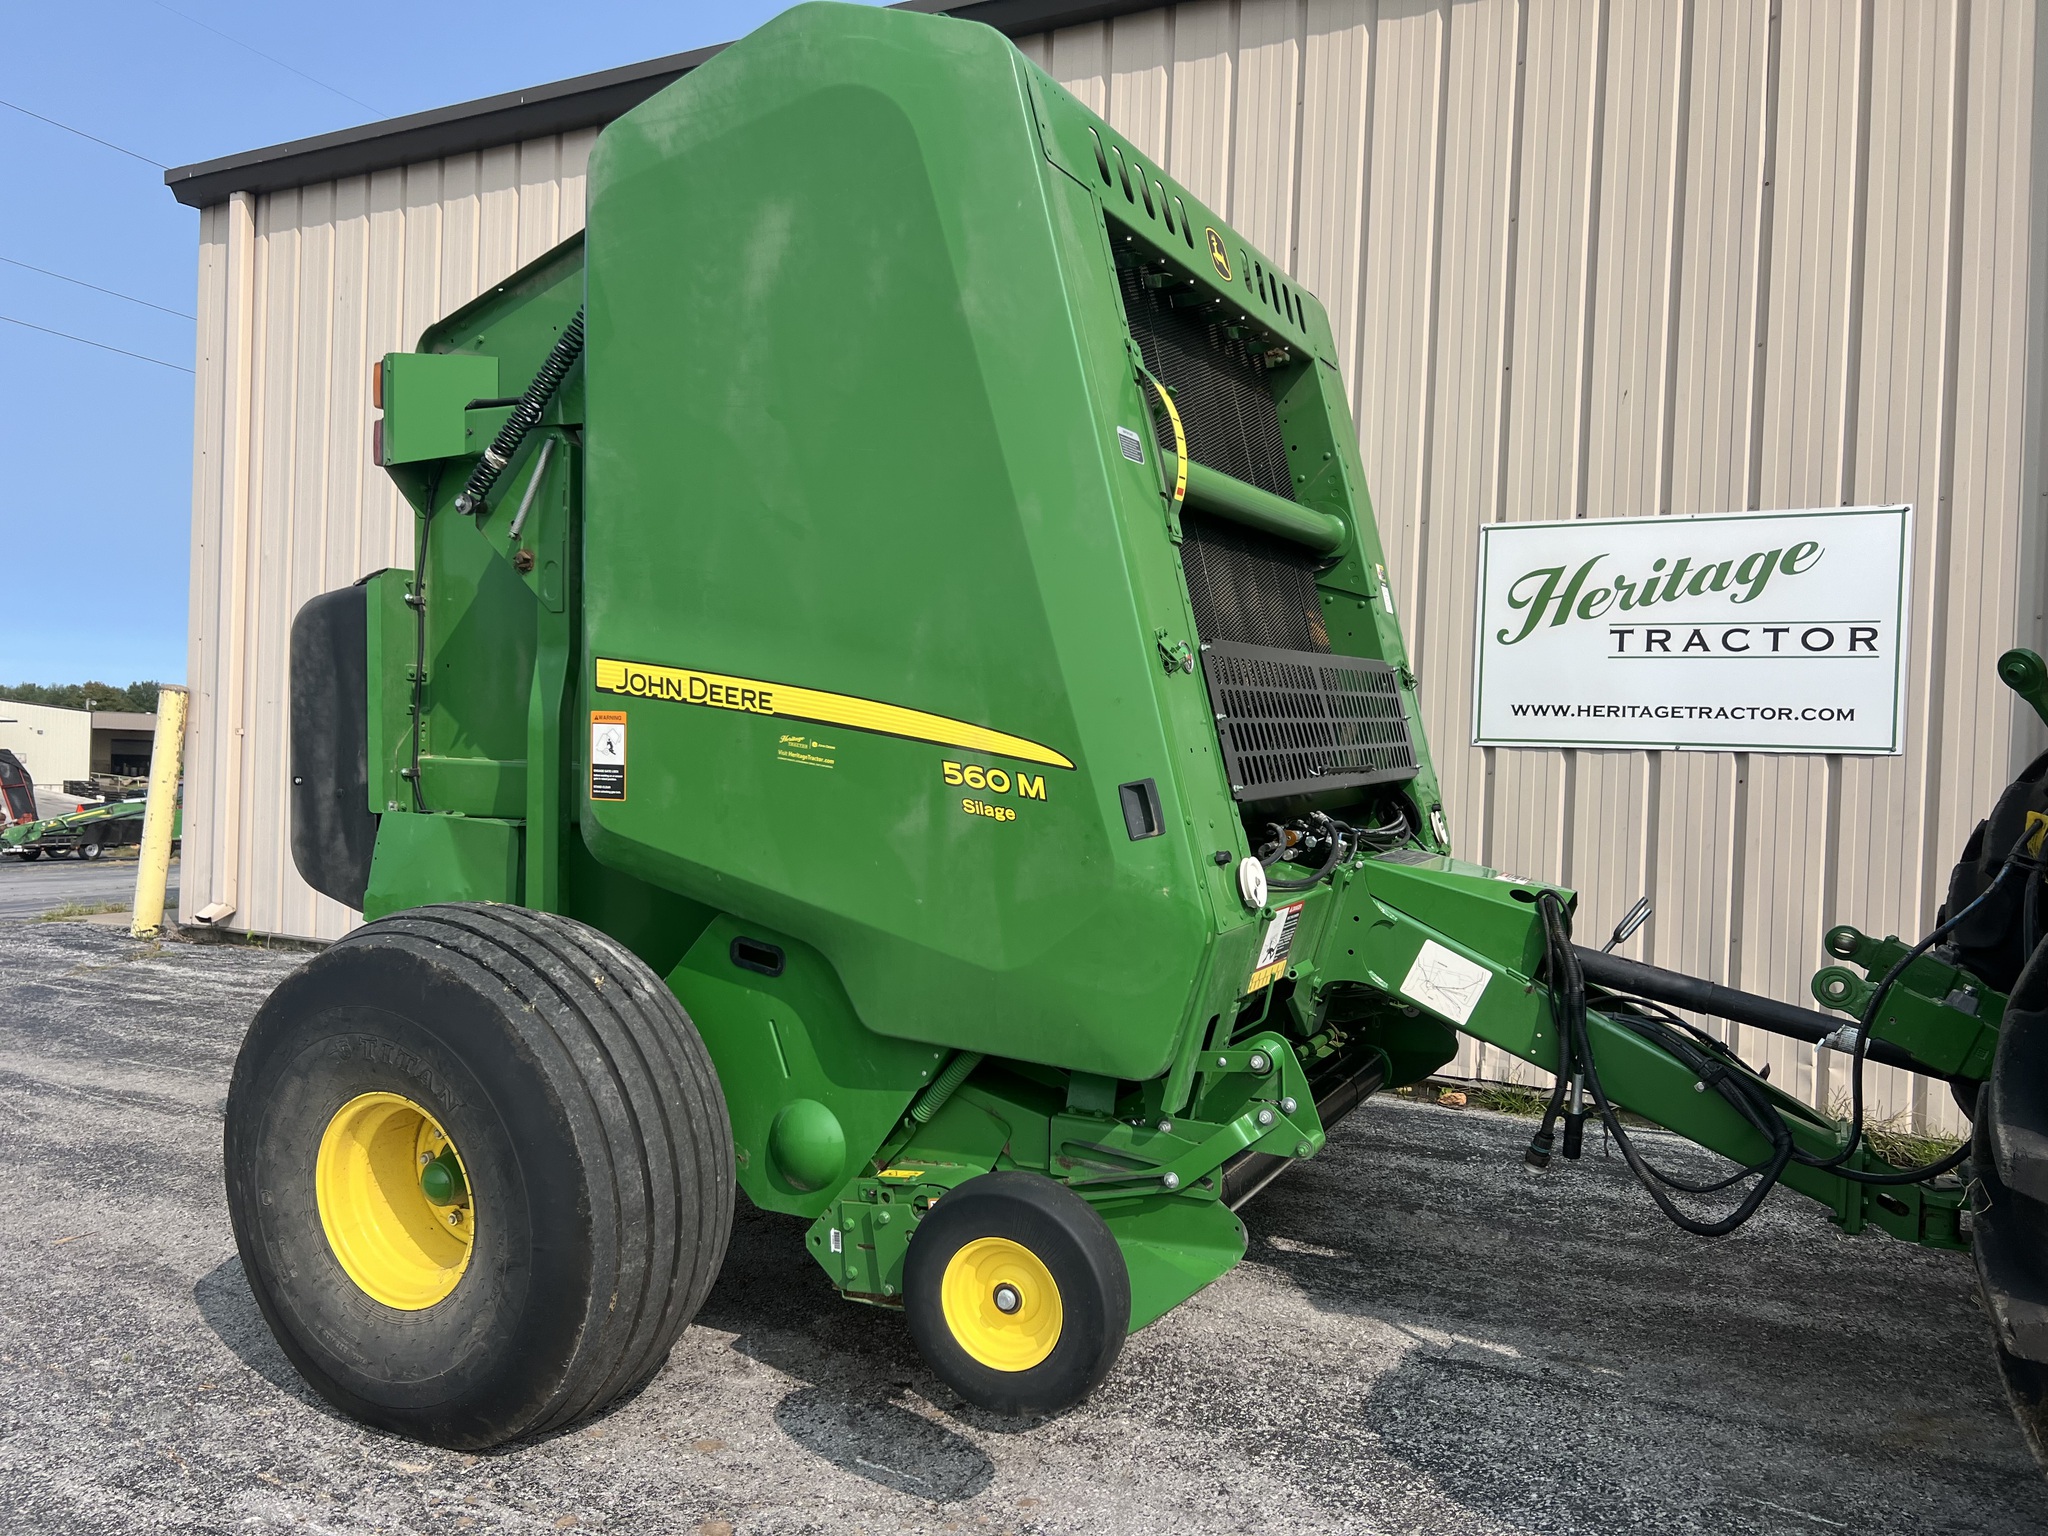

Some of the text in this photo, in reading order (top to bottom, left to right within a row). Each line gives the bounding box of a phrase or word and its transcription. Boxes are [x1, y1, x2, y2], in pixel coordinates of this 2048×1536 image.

[1496, 540, 1826, 646] Heritage
[1609, 626, 1880, 653] TRACTOR
[1511, 703, 1856, 722] WWW.HERITAGETRACTOR.COM
[941, 759, 1048, 802] 560 M
[961, 798, 1017, 822] Silage
[359, 1036, 465, 1112] TITAN
